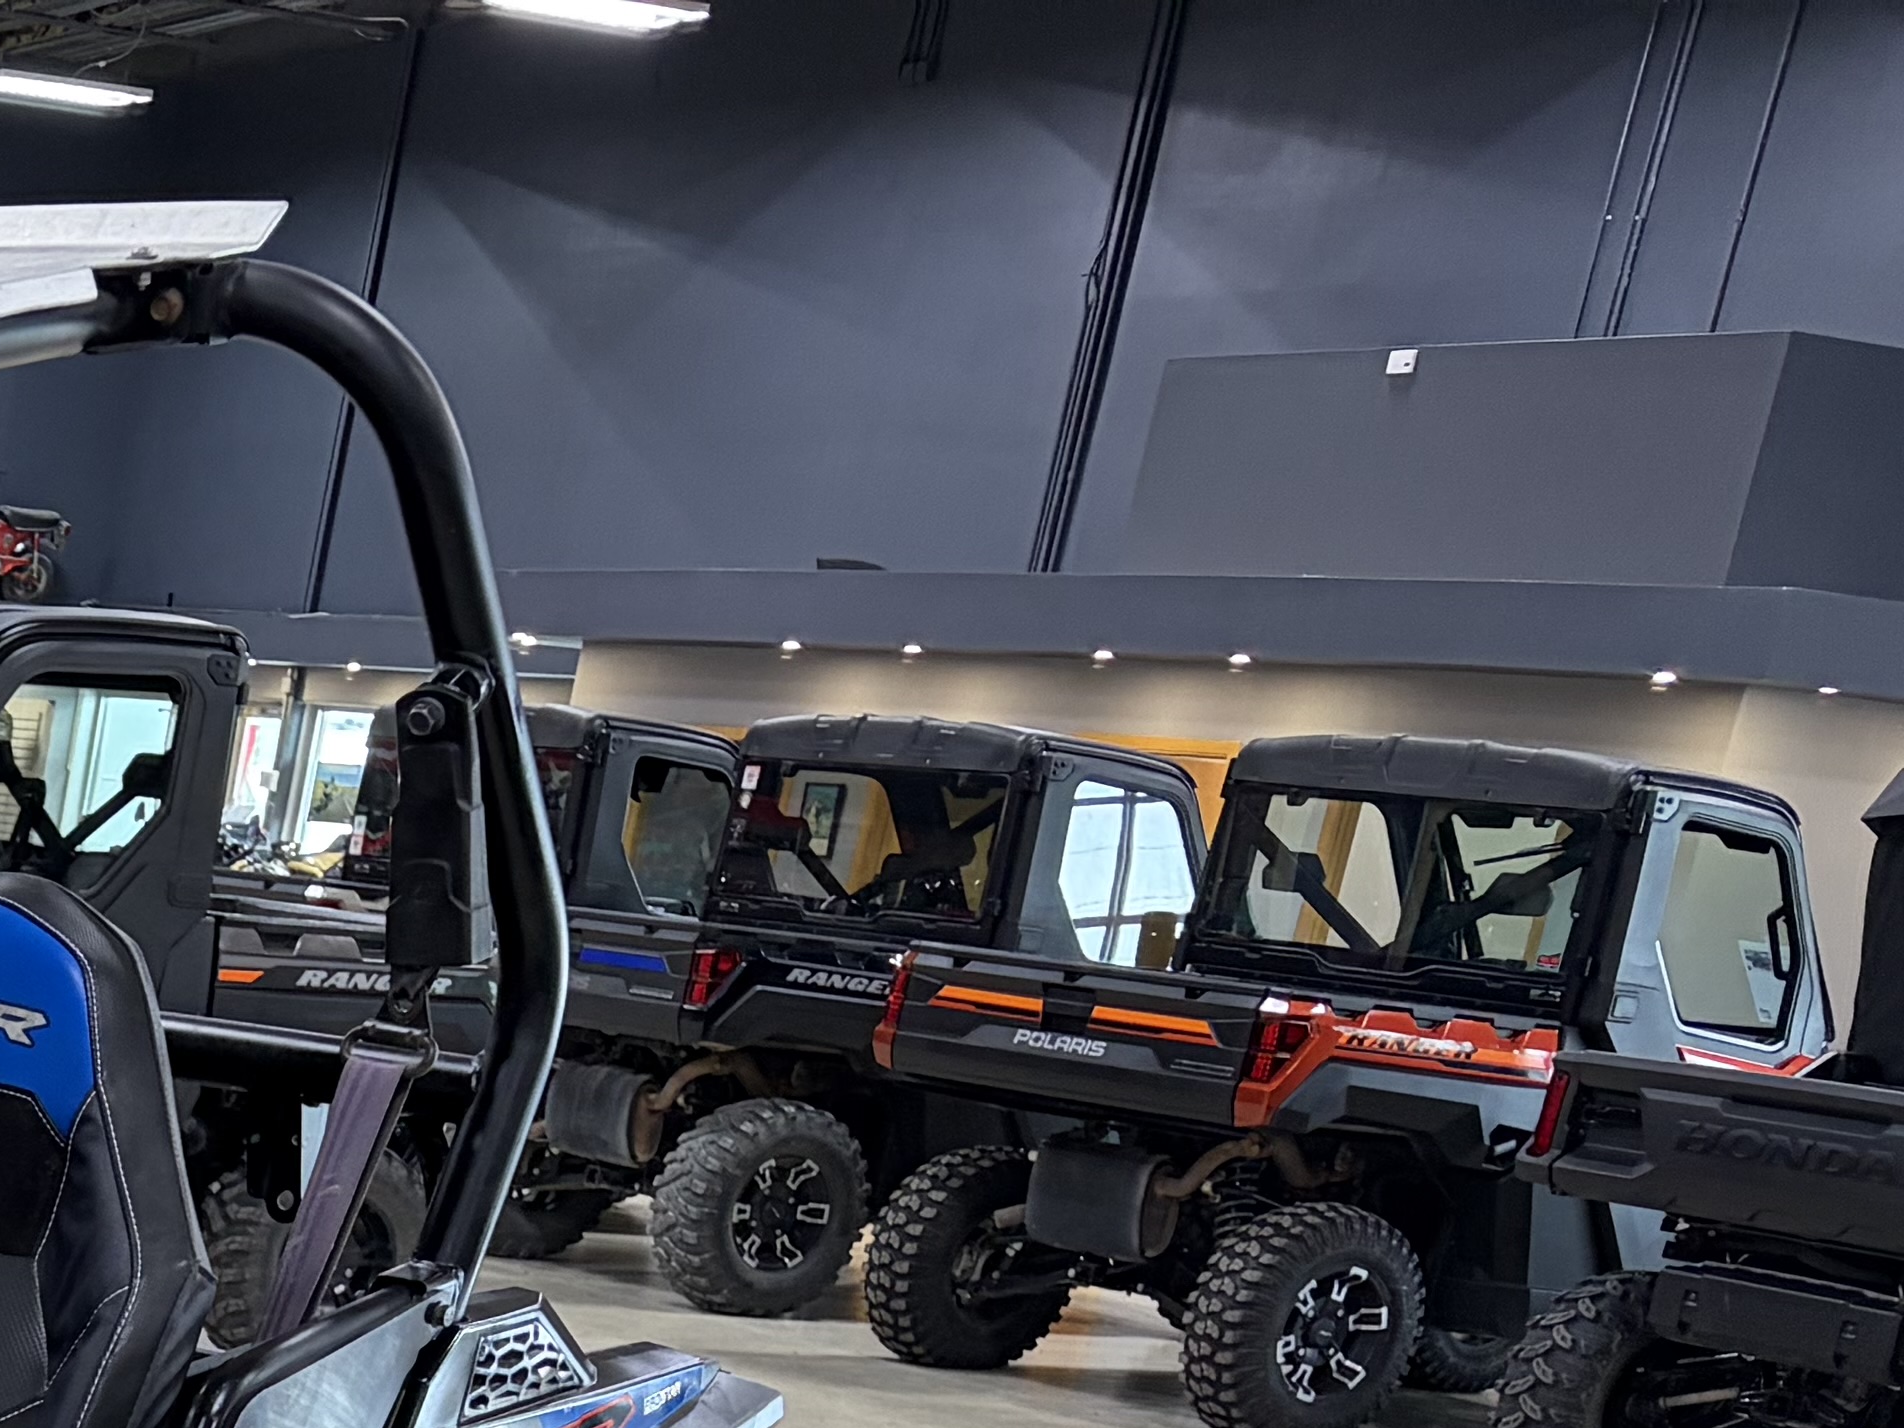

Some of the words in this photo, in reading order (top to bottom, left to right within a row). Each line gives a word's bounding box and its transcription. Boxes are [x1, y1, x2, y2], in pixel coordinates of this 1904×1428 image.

[296, 969, 452, 995] RANGR
[1012, 1028, 1107, 1057] POLARIS
[1675, 1119, 1901, 1184] HONDA
